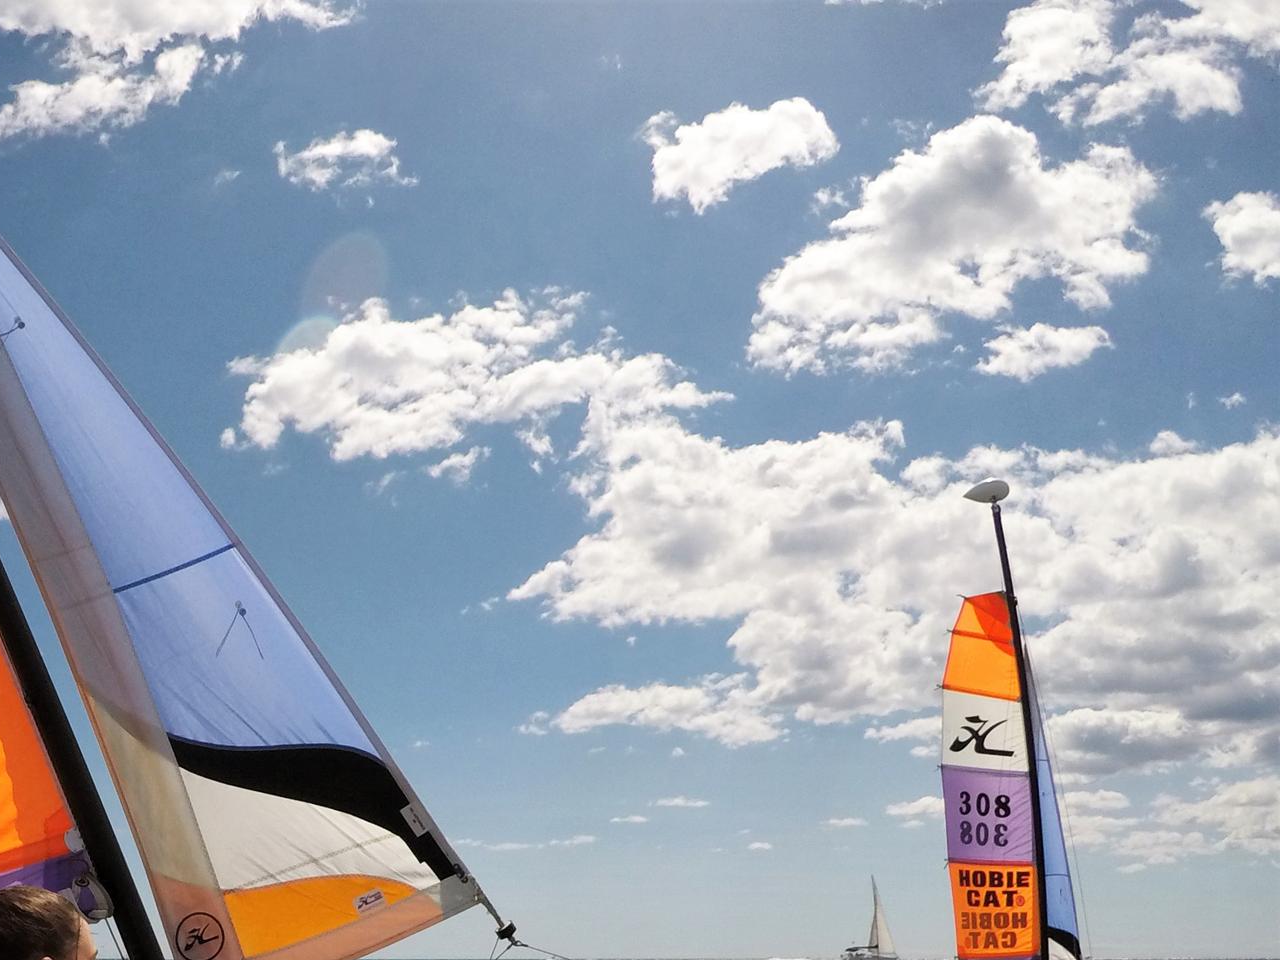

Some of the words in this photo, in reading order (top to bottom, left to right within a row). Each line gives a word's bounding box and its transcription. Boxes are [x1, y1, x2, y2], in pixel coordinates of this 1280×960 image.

[959, 791, 1011, 818] 308
[959, 869, 1030, 888] HOBIE
[967, 890, 1018, 907] CAT
